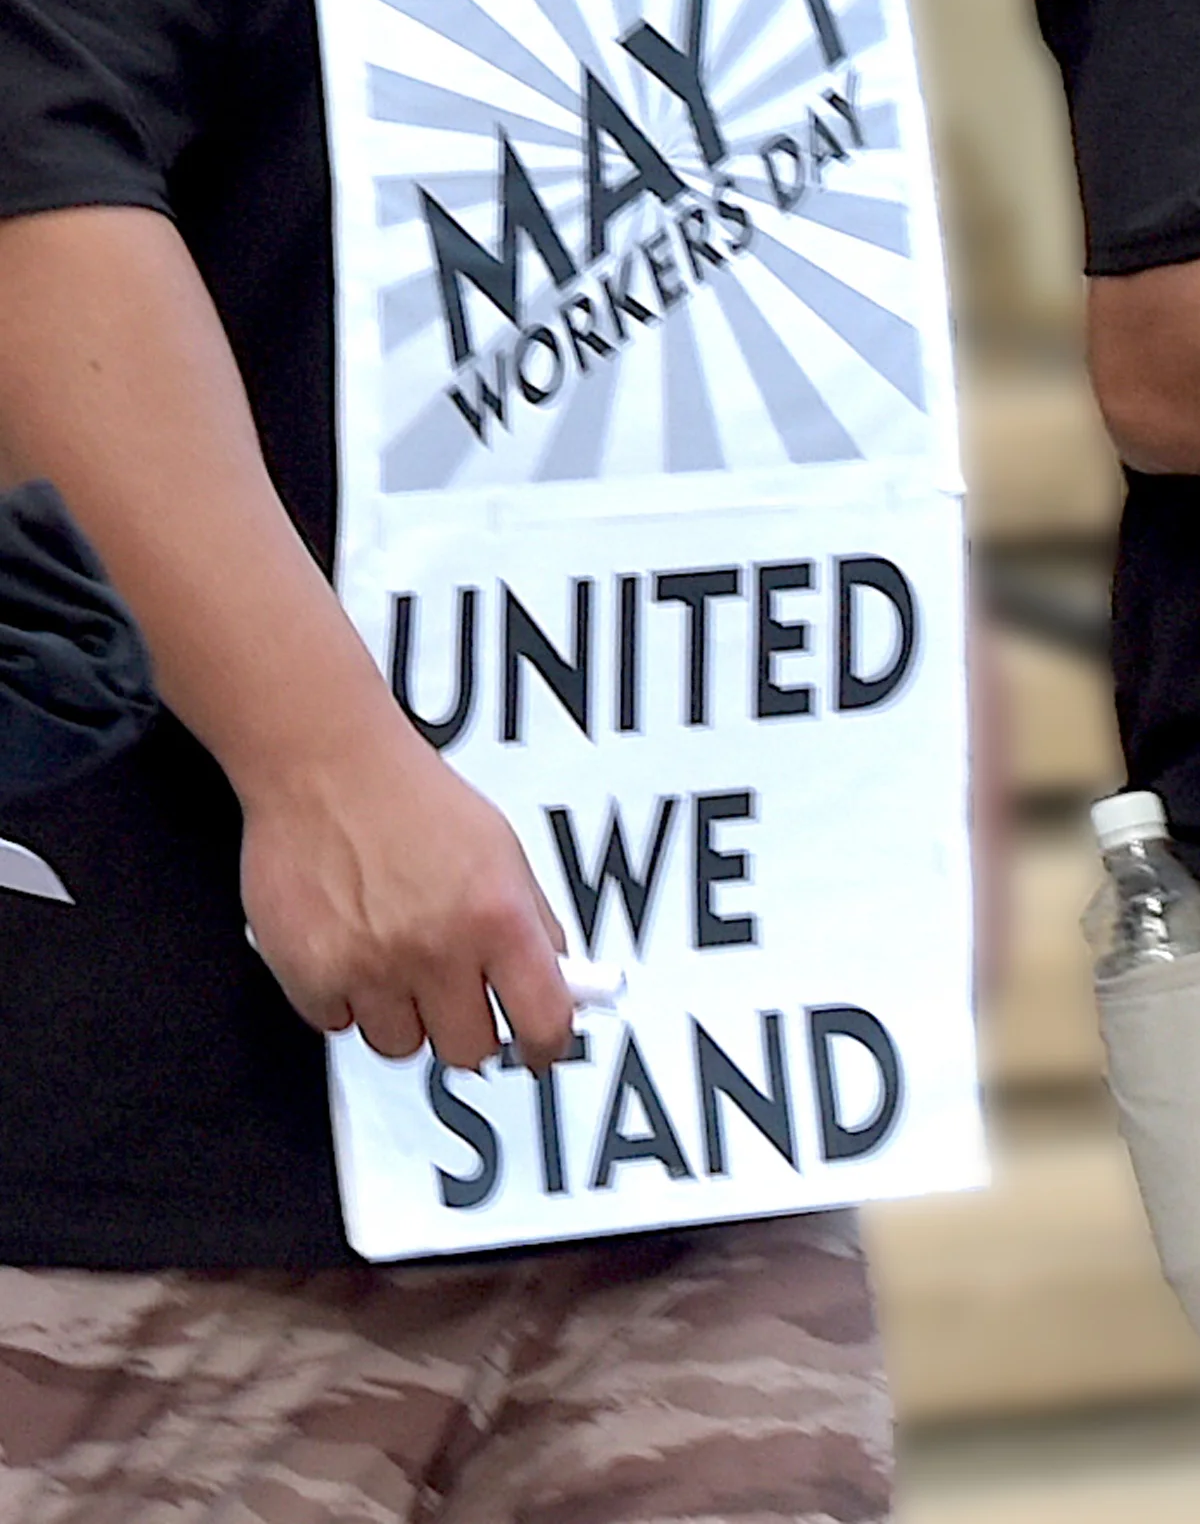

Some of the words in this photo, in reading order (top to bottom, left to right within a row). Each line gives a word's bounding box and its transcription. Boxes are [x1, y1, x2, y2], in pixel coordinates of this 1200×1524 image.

[446, 176, 755, 448] WORKERS
[760, 71, 866, 214] DAY
[390, 553, 923, 750] UNITED
[545, 789, 759, 960] WE
[427, 1003, 902, 1209] STAND
